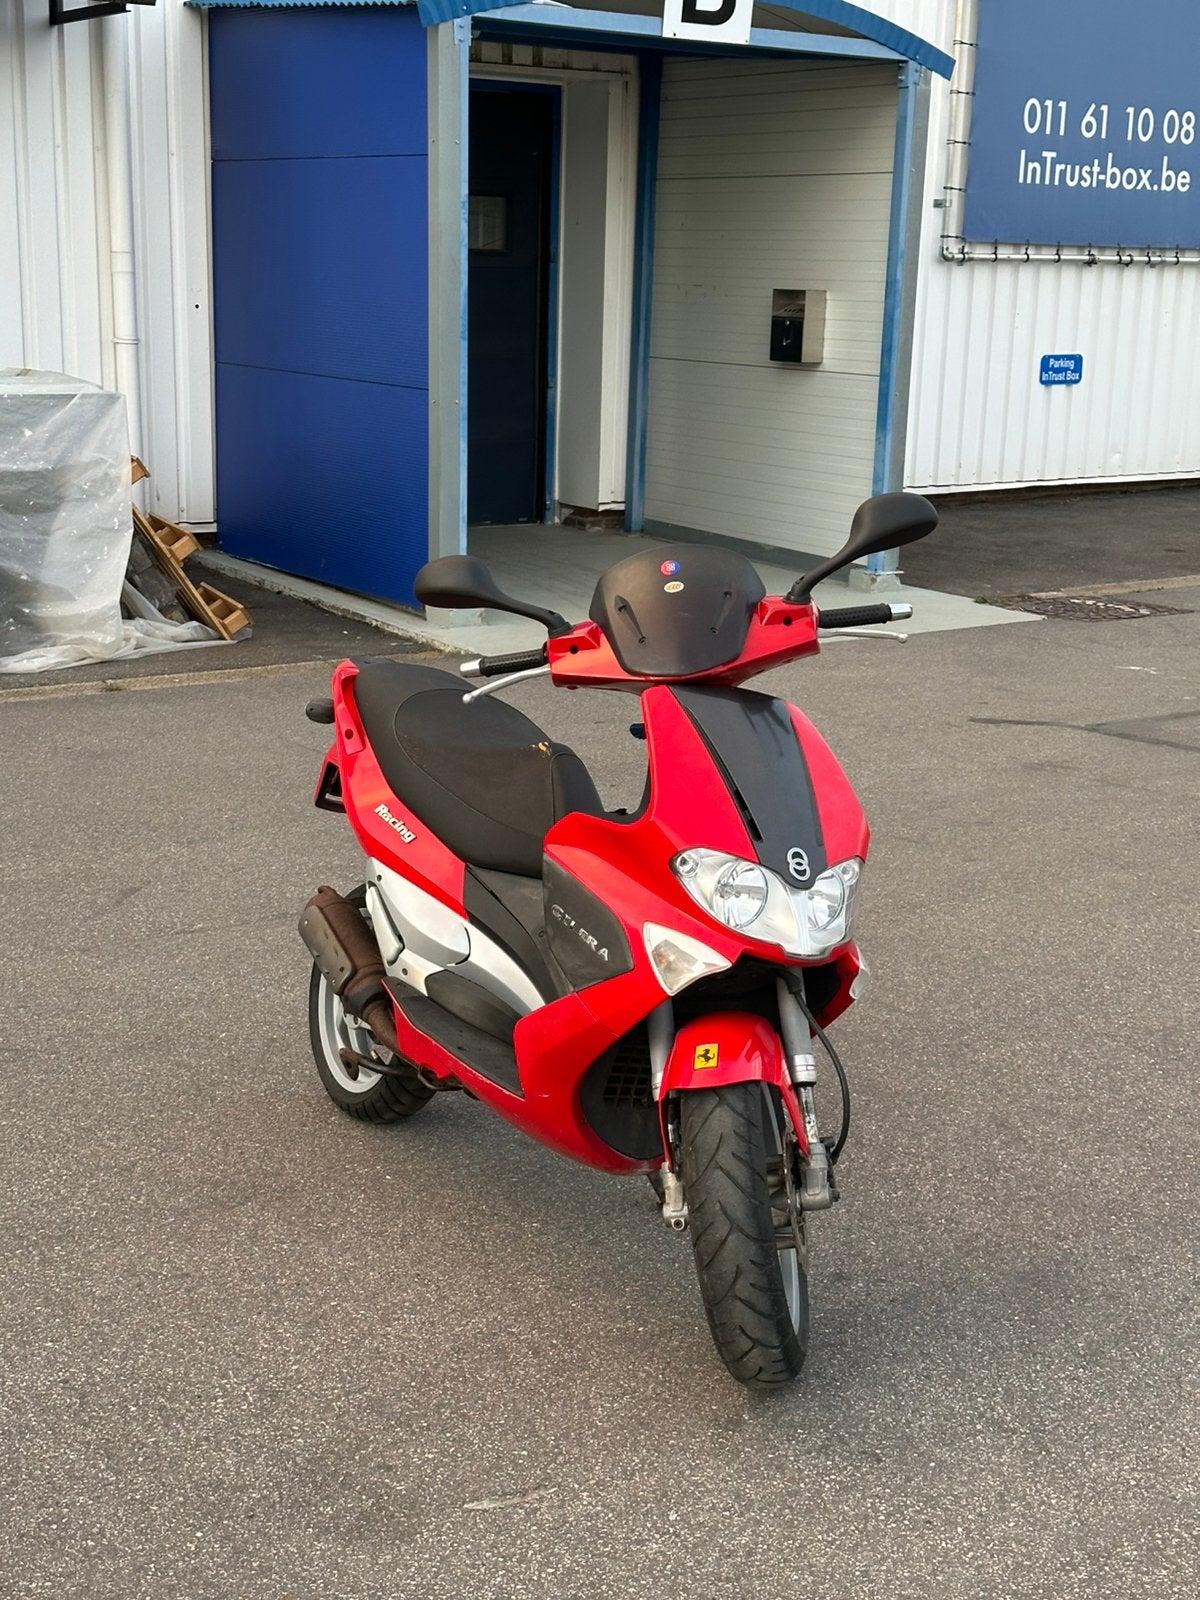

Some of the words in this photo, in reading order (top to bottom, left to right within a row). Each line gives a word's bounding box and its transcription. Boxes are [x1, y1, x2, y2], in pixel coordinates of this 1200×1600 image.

[1023, 97, 1067, 136] 011
[1080, 103, 1109, 139] 61
[1126, 106, 1155, 142] 10
[1163, 109, 1196, 145] 08
[1018, 149, 1191, 192] InTrust-box.be
[1042, 371, 1066, 381] InTrust
[1066, 370, 1080, 381] Box
[1049, 358, 1075, 370] Parking
[373, 803, 418, 844] Racing
